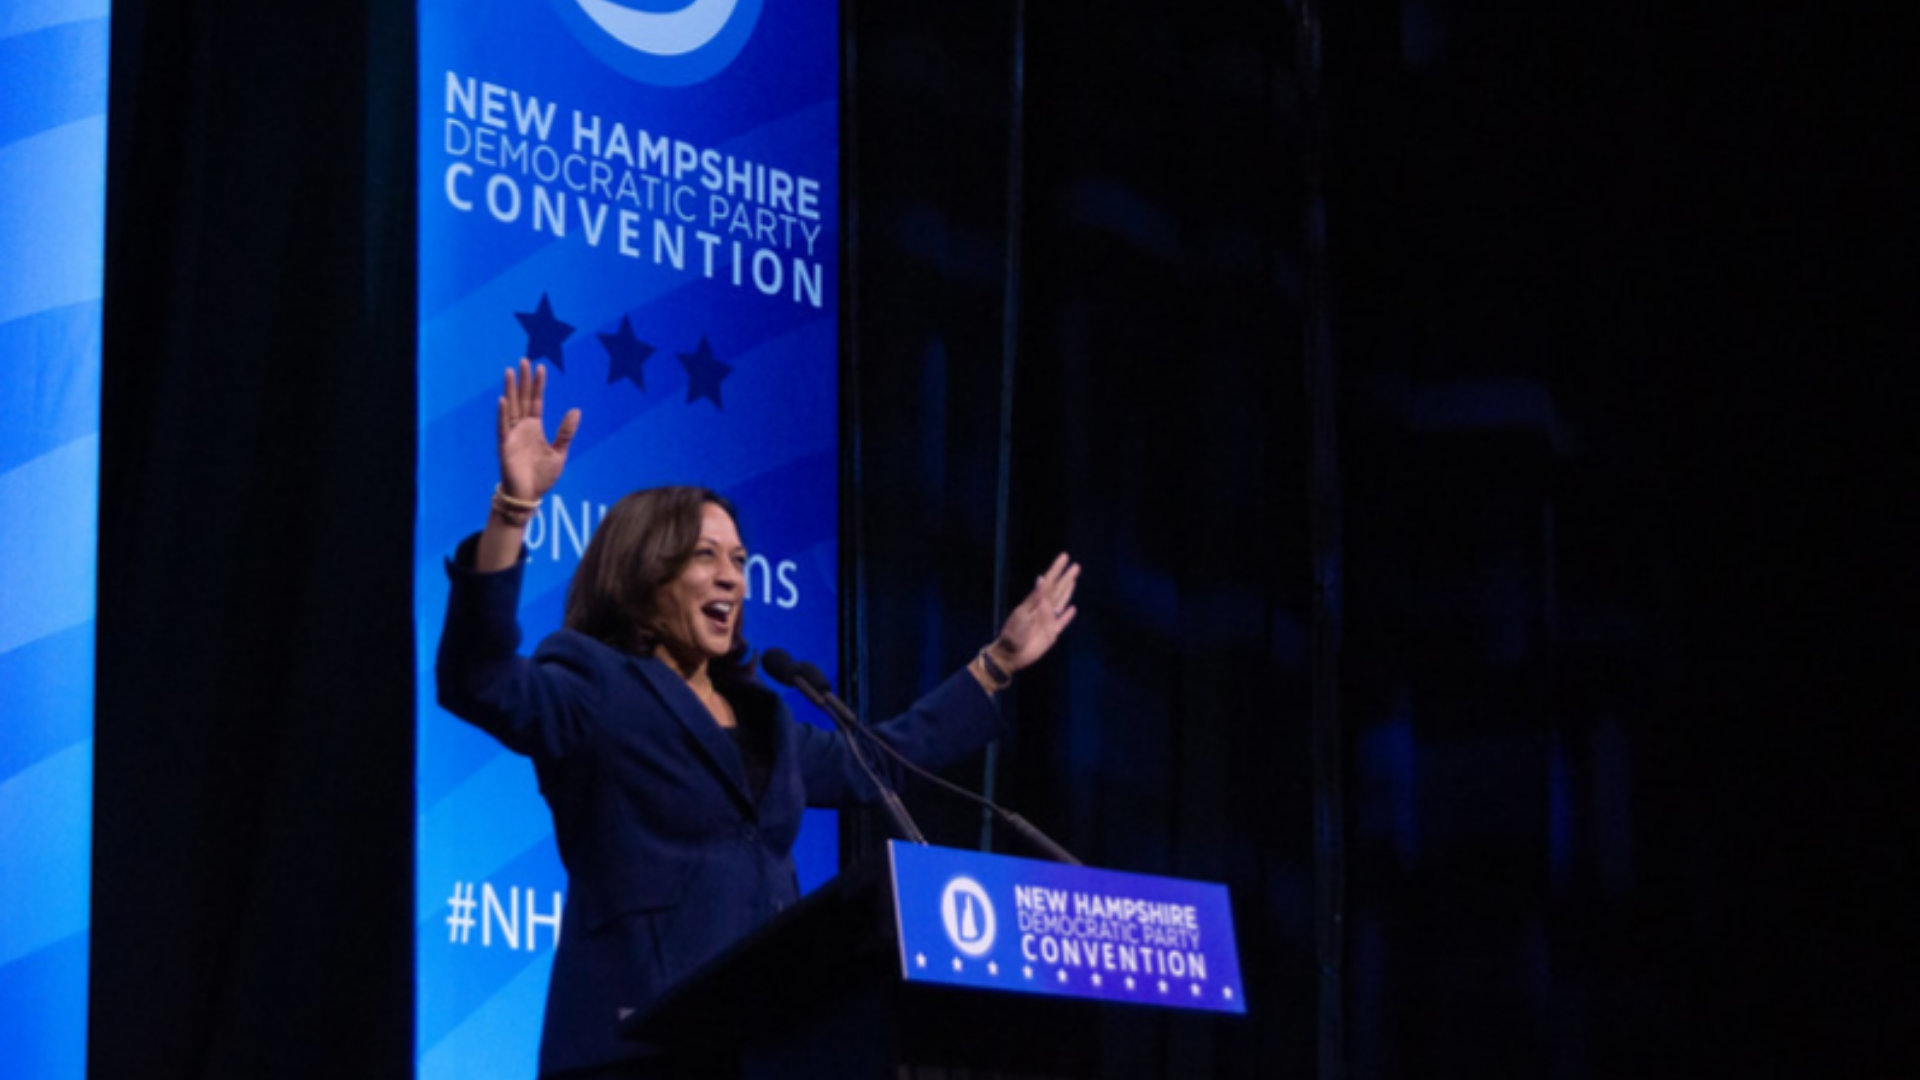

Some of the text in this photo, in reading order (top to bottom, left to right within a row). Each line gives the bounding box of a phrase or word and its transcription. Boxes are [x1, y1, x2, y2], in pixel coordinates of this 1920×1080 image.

[446, 71, 820, 220] NEW HAMPSHIRE
[446, 119, 821, 256] DEMOCRATIC PARTY
[445, 163, 822, 307] CONVENTION
[1015, 885, 1197, 929] NEW HAMPSHIRE
[1018, 910, 1201, 949] DEMOCRATIC PARTY
[1022, 934, 1206, 979] CONVENTION
